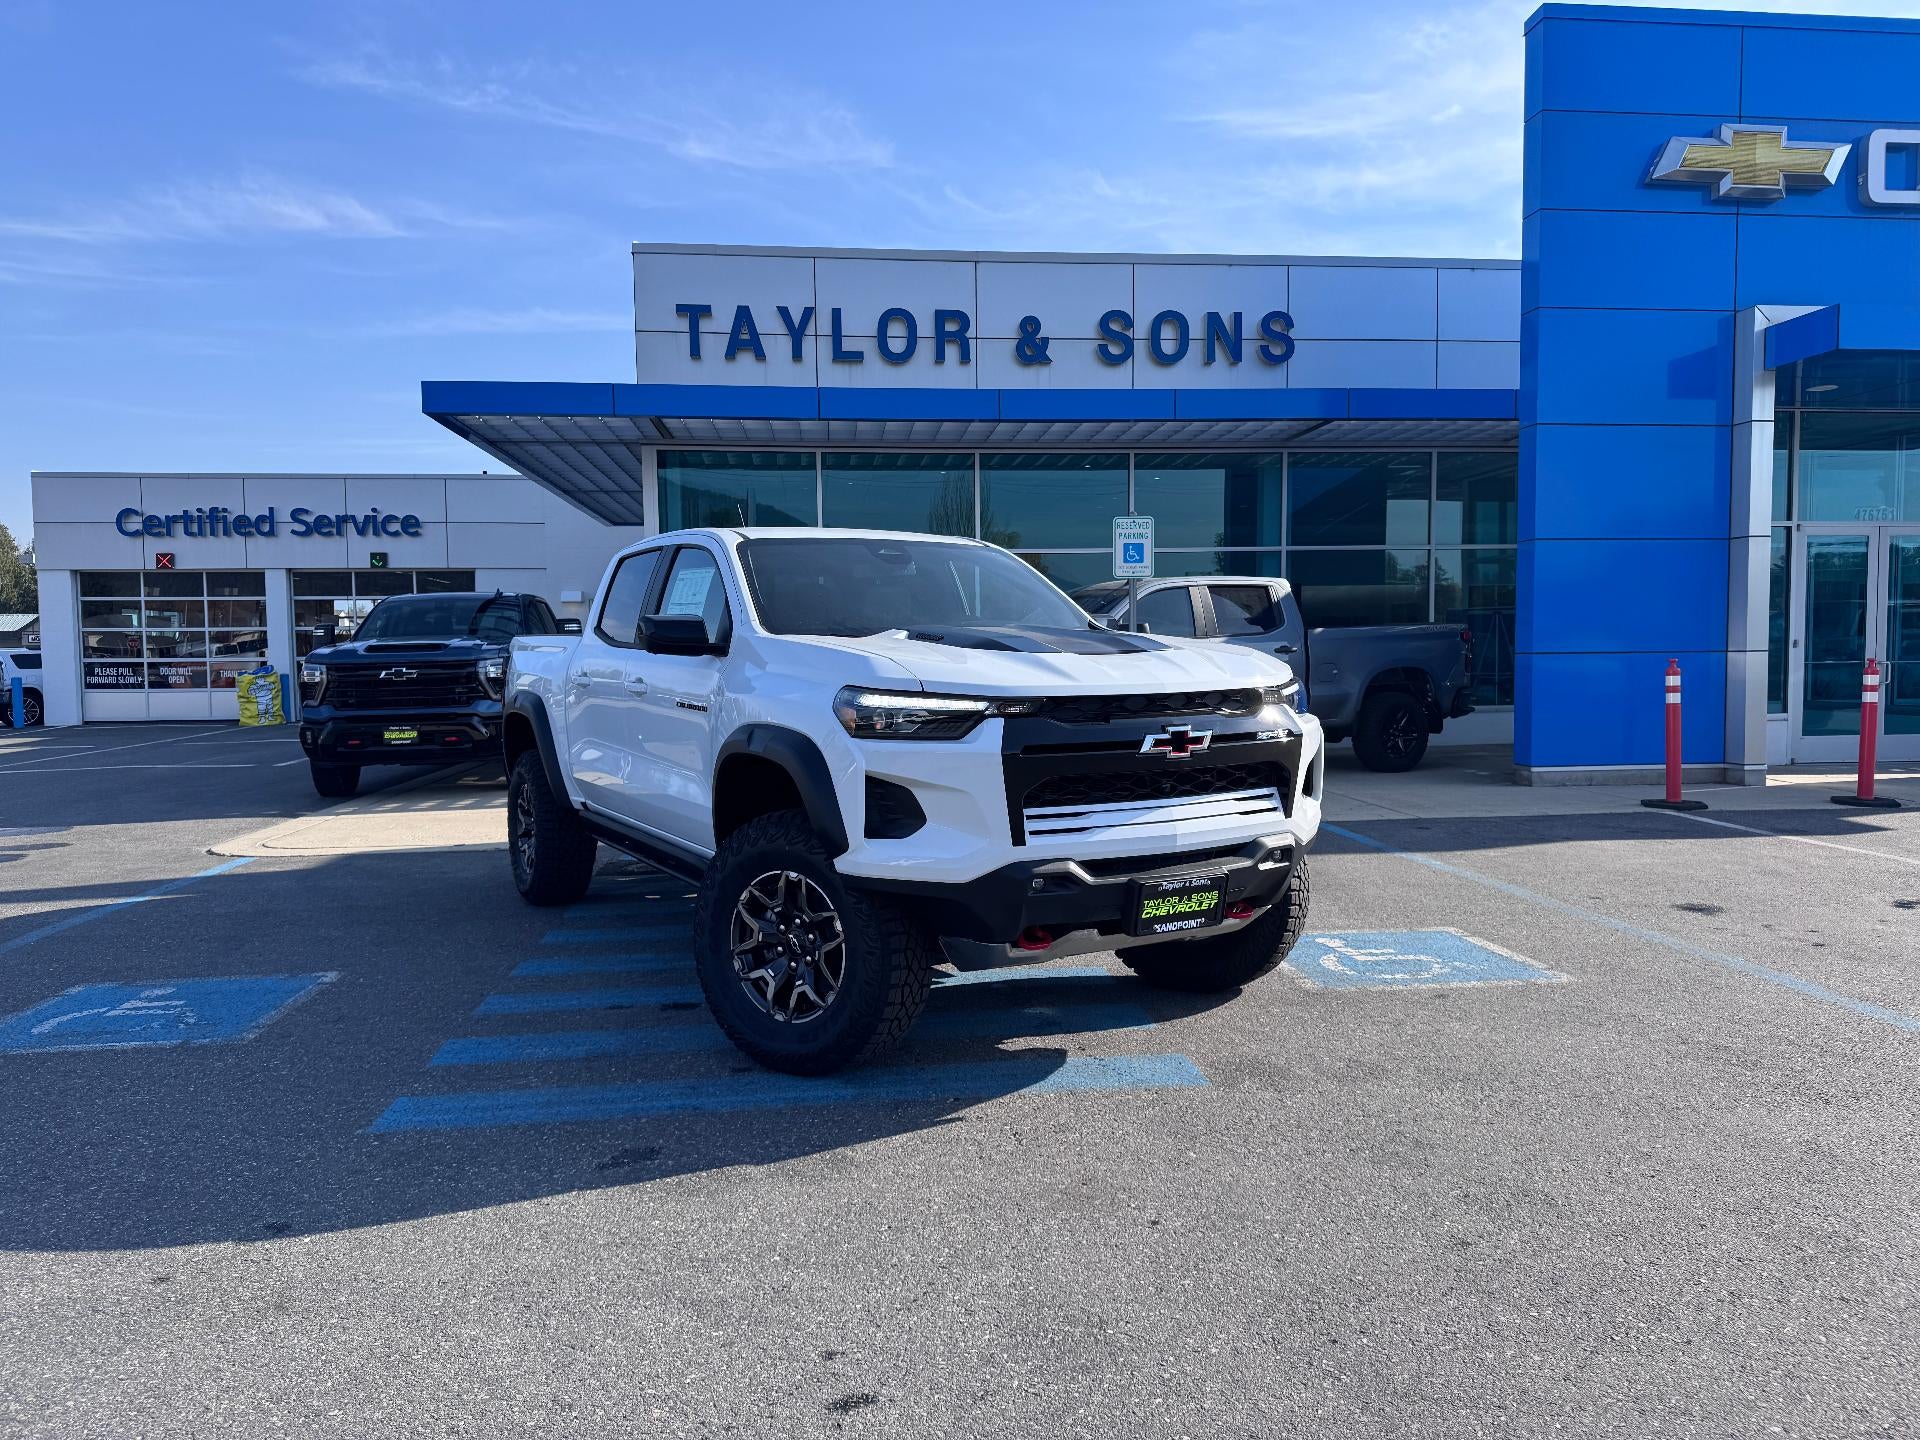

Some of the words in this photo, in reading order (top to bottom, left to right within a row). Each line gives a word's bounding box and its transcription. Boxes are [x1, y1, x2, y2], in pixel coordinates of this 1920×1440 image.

[675, 303, 971, 363] TAYLOR
[1015, 314, 1052, 364] &
[1097, 308, 1296, 365] SONS
[115, 506, 276, 538] Certified
[289, 507, 422, 538] Service
[1116, 522, 1150, 530] RESERVED
[1118, 532, 1149, 540] PARKING
[94, 667, 118, 676] PLEASE
[118, 667, 134, 676] PULL
[160, 667, 177, 676] DOOR
[177, 667, 193, 676] WILL
[86, 676, 117, 685] FORWARD
[117, 676, 143, 685] SLOWLY
[168, 675, 185, 684] OPEN
[1162, 881, 1184, 891] Taylor
[1190, 878, 1208, 887] Sons
[1144, 896, 1179, 907] TAYLOR
[1181, 895, 1189, 904] &
[1191, 891, 1219, 900] SONS
[1141, 900, 1218, 918] CHEVROLET
